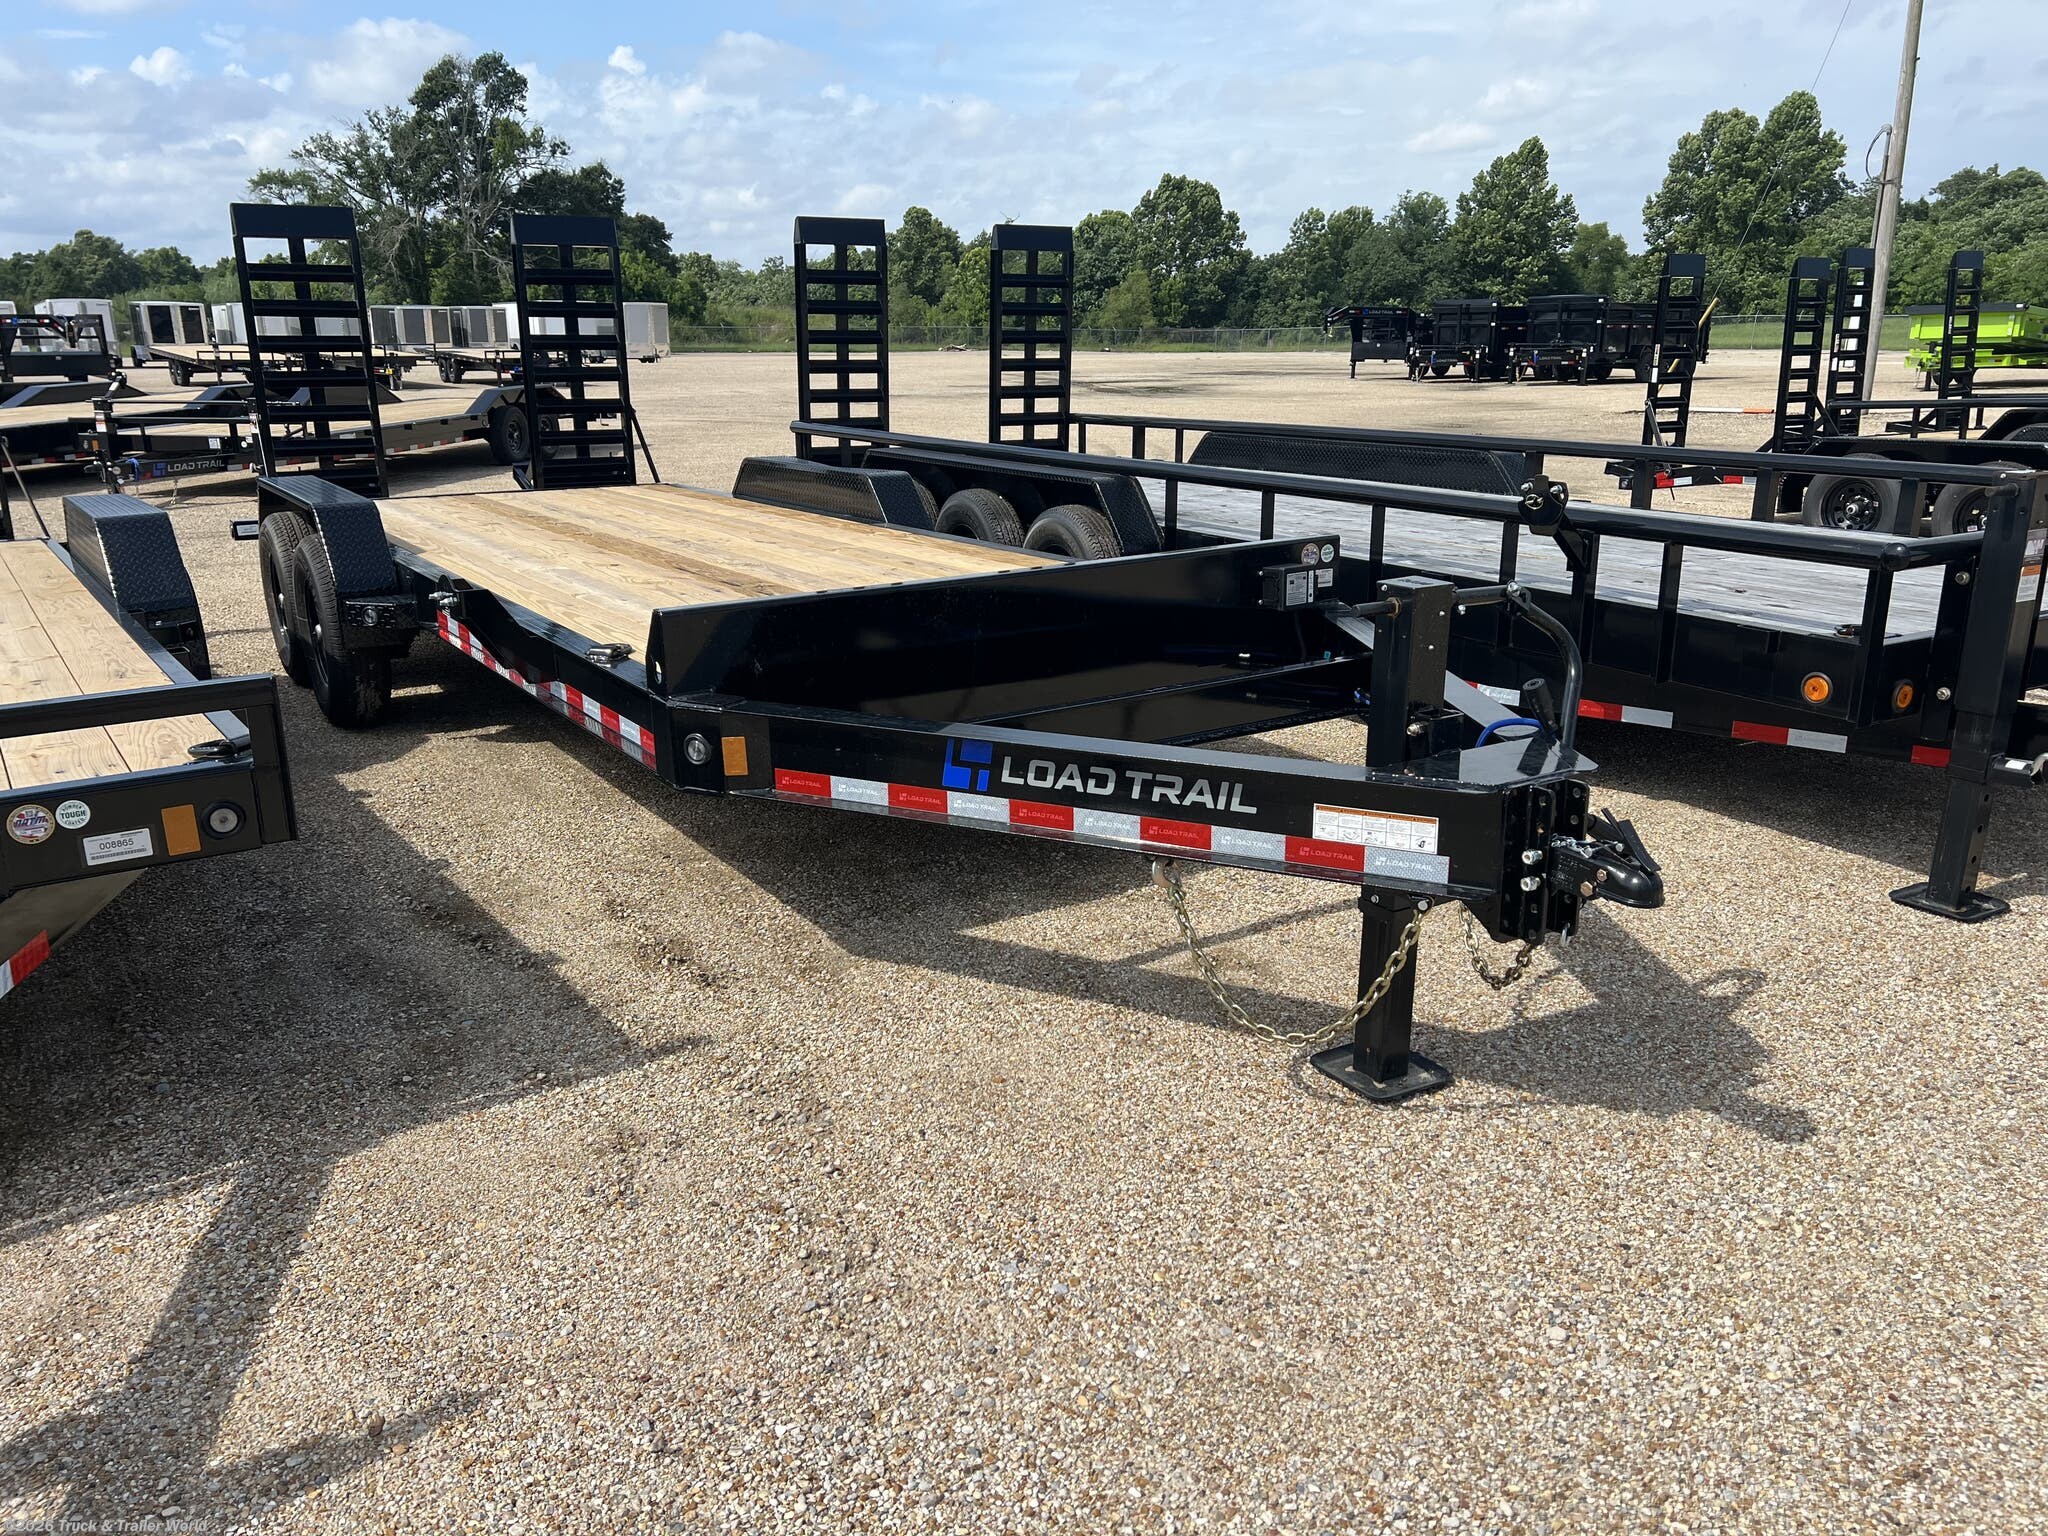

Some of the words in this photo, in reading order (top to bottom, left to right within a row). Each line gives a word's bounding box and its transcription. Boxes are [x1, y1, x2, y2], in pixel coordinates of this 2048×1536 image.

[167, 462, 195, 472] LOAD
[196, 460, 225, 469] TRAIL
[1001, 756, 1117, 796] LOAD
[1125, 770, 1258, 815] TRAIL
[907, 794, 924, 802] LOAD
[924, 796, 942, 805] TRAIL
[60, 810, 86, 819] TOUGH
[1045, 813, 1064, 821] TRAIL
[1158, 828, 1178, 836] LOAD
[1178, 831, 1200, 839] TRAIL
[99, 838, 134, 850] 008865
[1310, 850, 1332, 859] LOAD
[1332, 852, 1355, 861] TRAIL
[1386, 860, 1409, 868] LOAD
[1410, 862, 1433, 871] TRAIL
